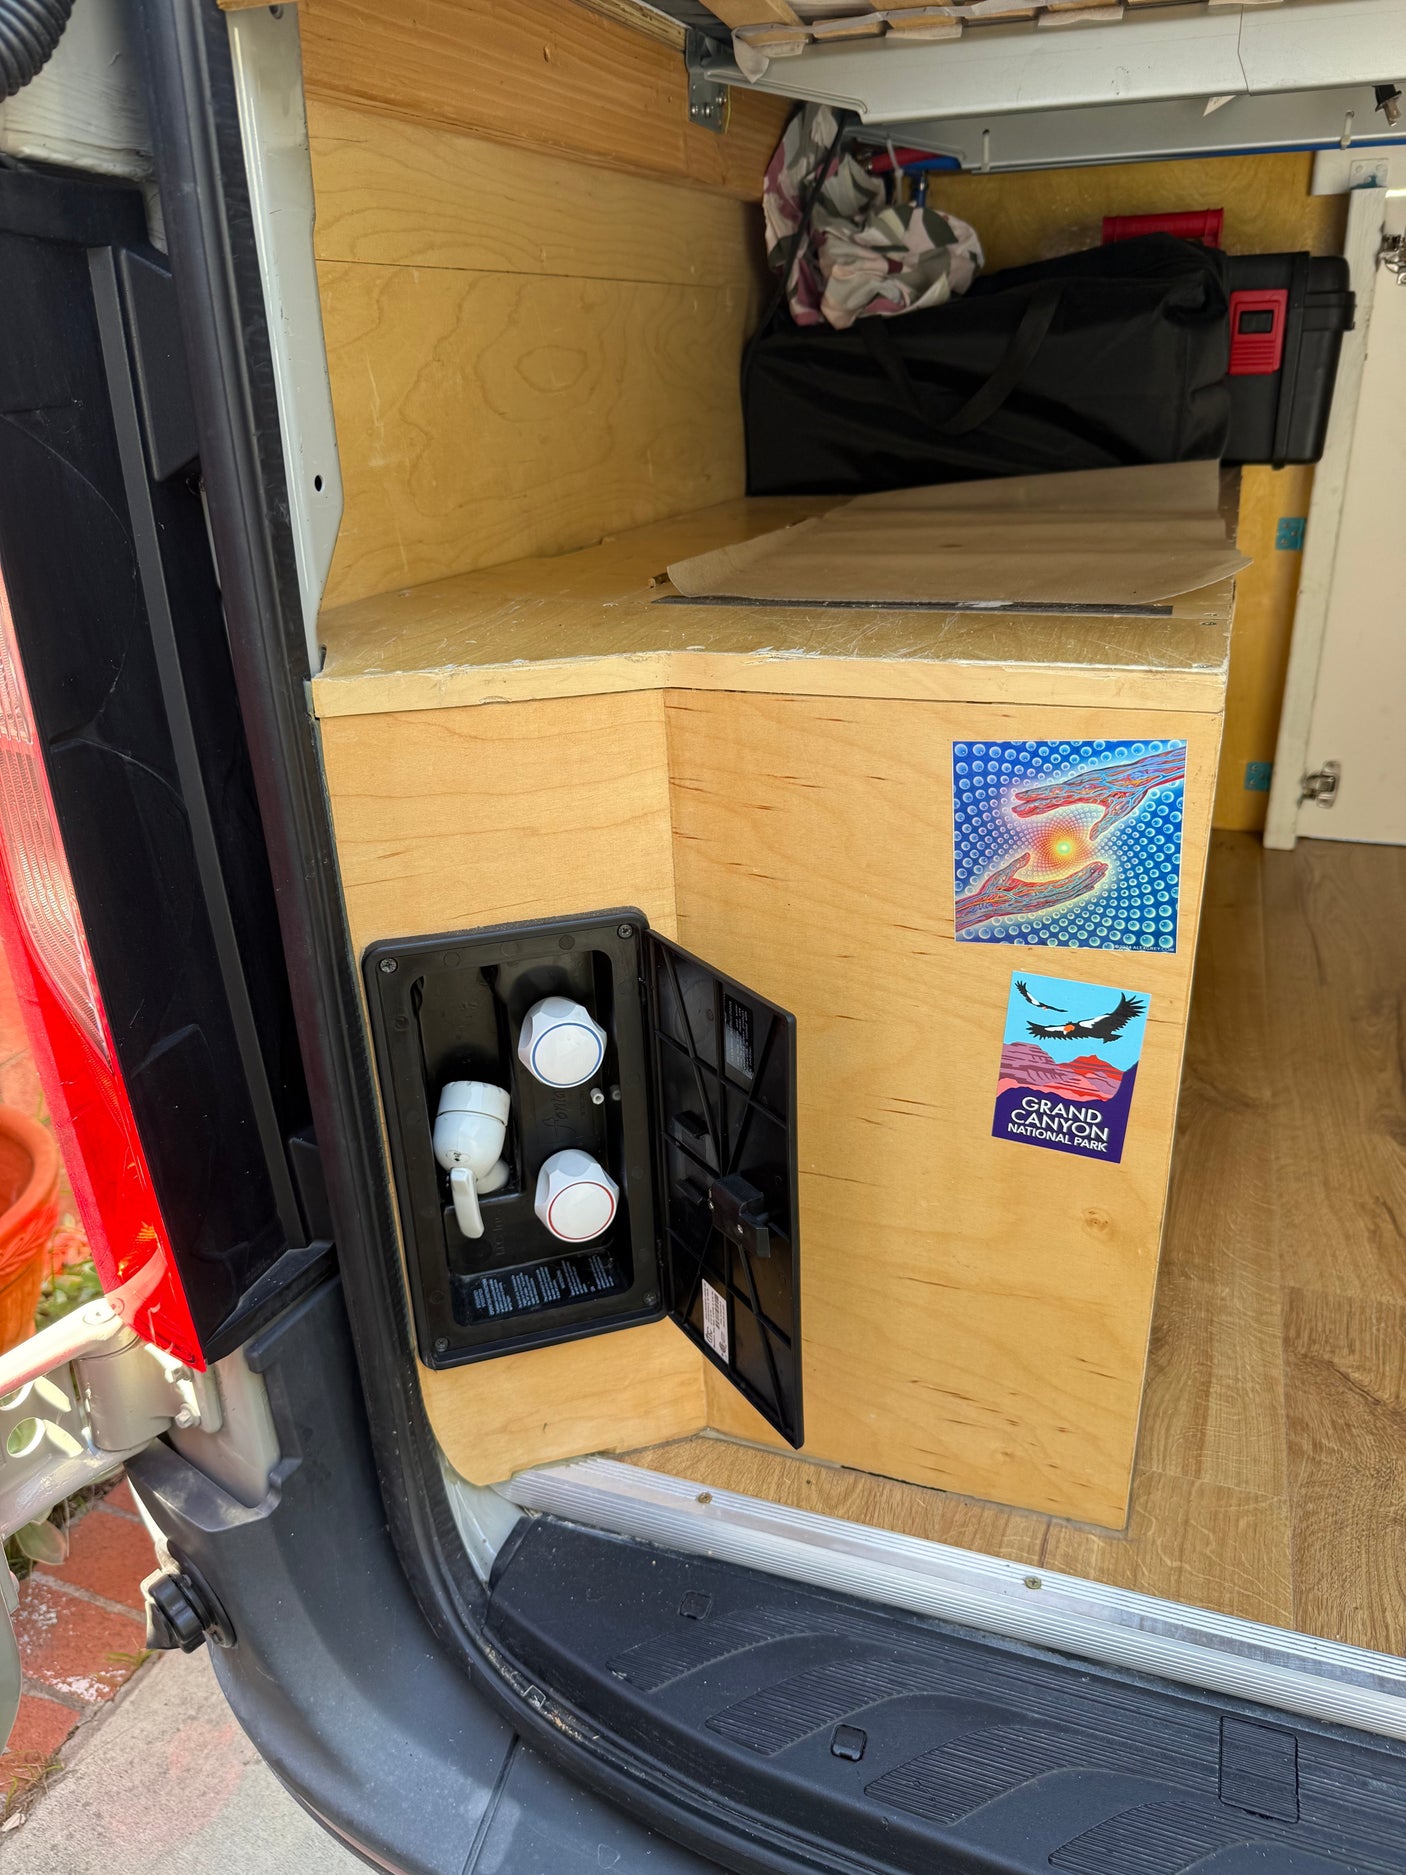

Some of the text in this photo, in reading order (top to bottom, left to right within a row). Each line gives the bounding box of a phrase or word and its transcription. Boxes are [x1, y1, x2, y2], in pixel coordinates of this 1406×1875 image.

[1011, 1109, 1109, 1141] CANYON
[1021, 1096, 1102, 1124] GRAND
[1007, 1122, 1108, 1152] NATIONAL PARK
